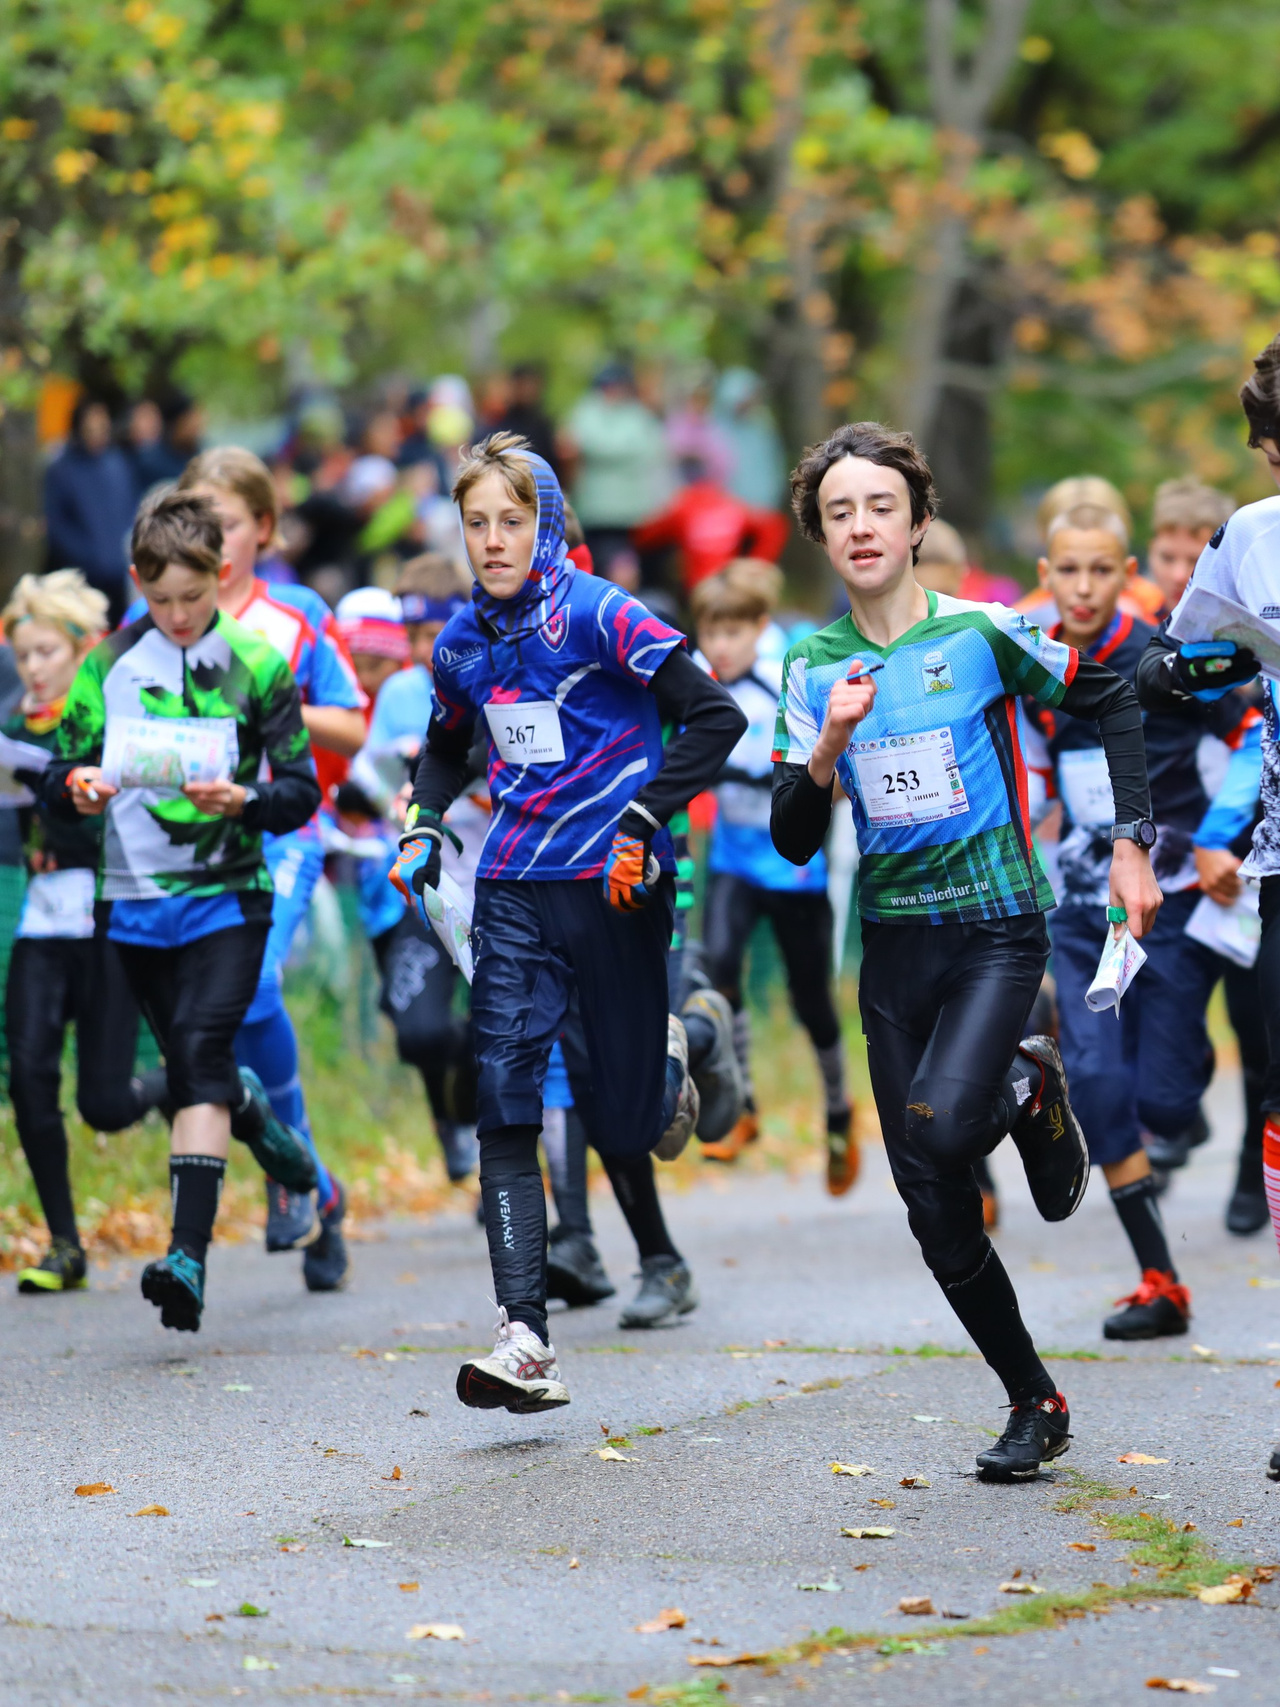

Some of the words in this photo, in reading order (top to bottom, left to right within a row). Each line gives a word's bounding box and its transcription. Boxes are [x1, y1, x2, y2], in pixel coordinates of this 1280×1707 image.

[505, 725, 536, 745] 267
[529, 747, 553, 755] линия
[882, 769, 921, 795] 253
[905, 794, 911, 803] 3
[912, 791, 940, 802] линия
[894, 811, 913, 820] РОССИИ
[904, 813, 944, 824] СОРЕВНОВАНИЯ
[890, 881, 989, 906] www.belcdtur.ru
